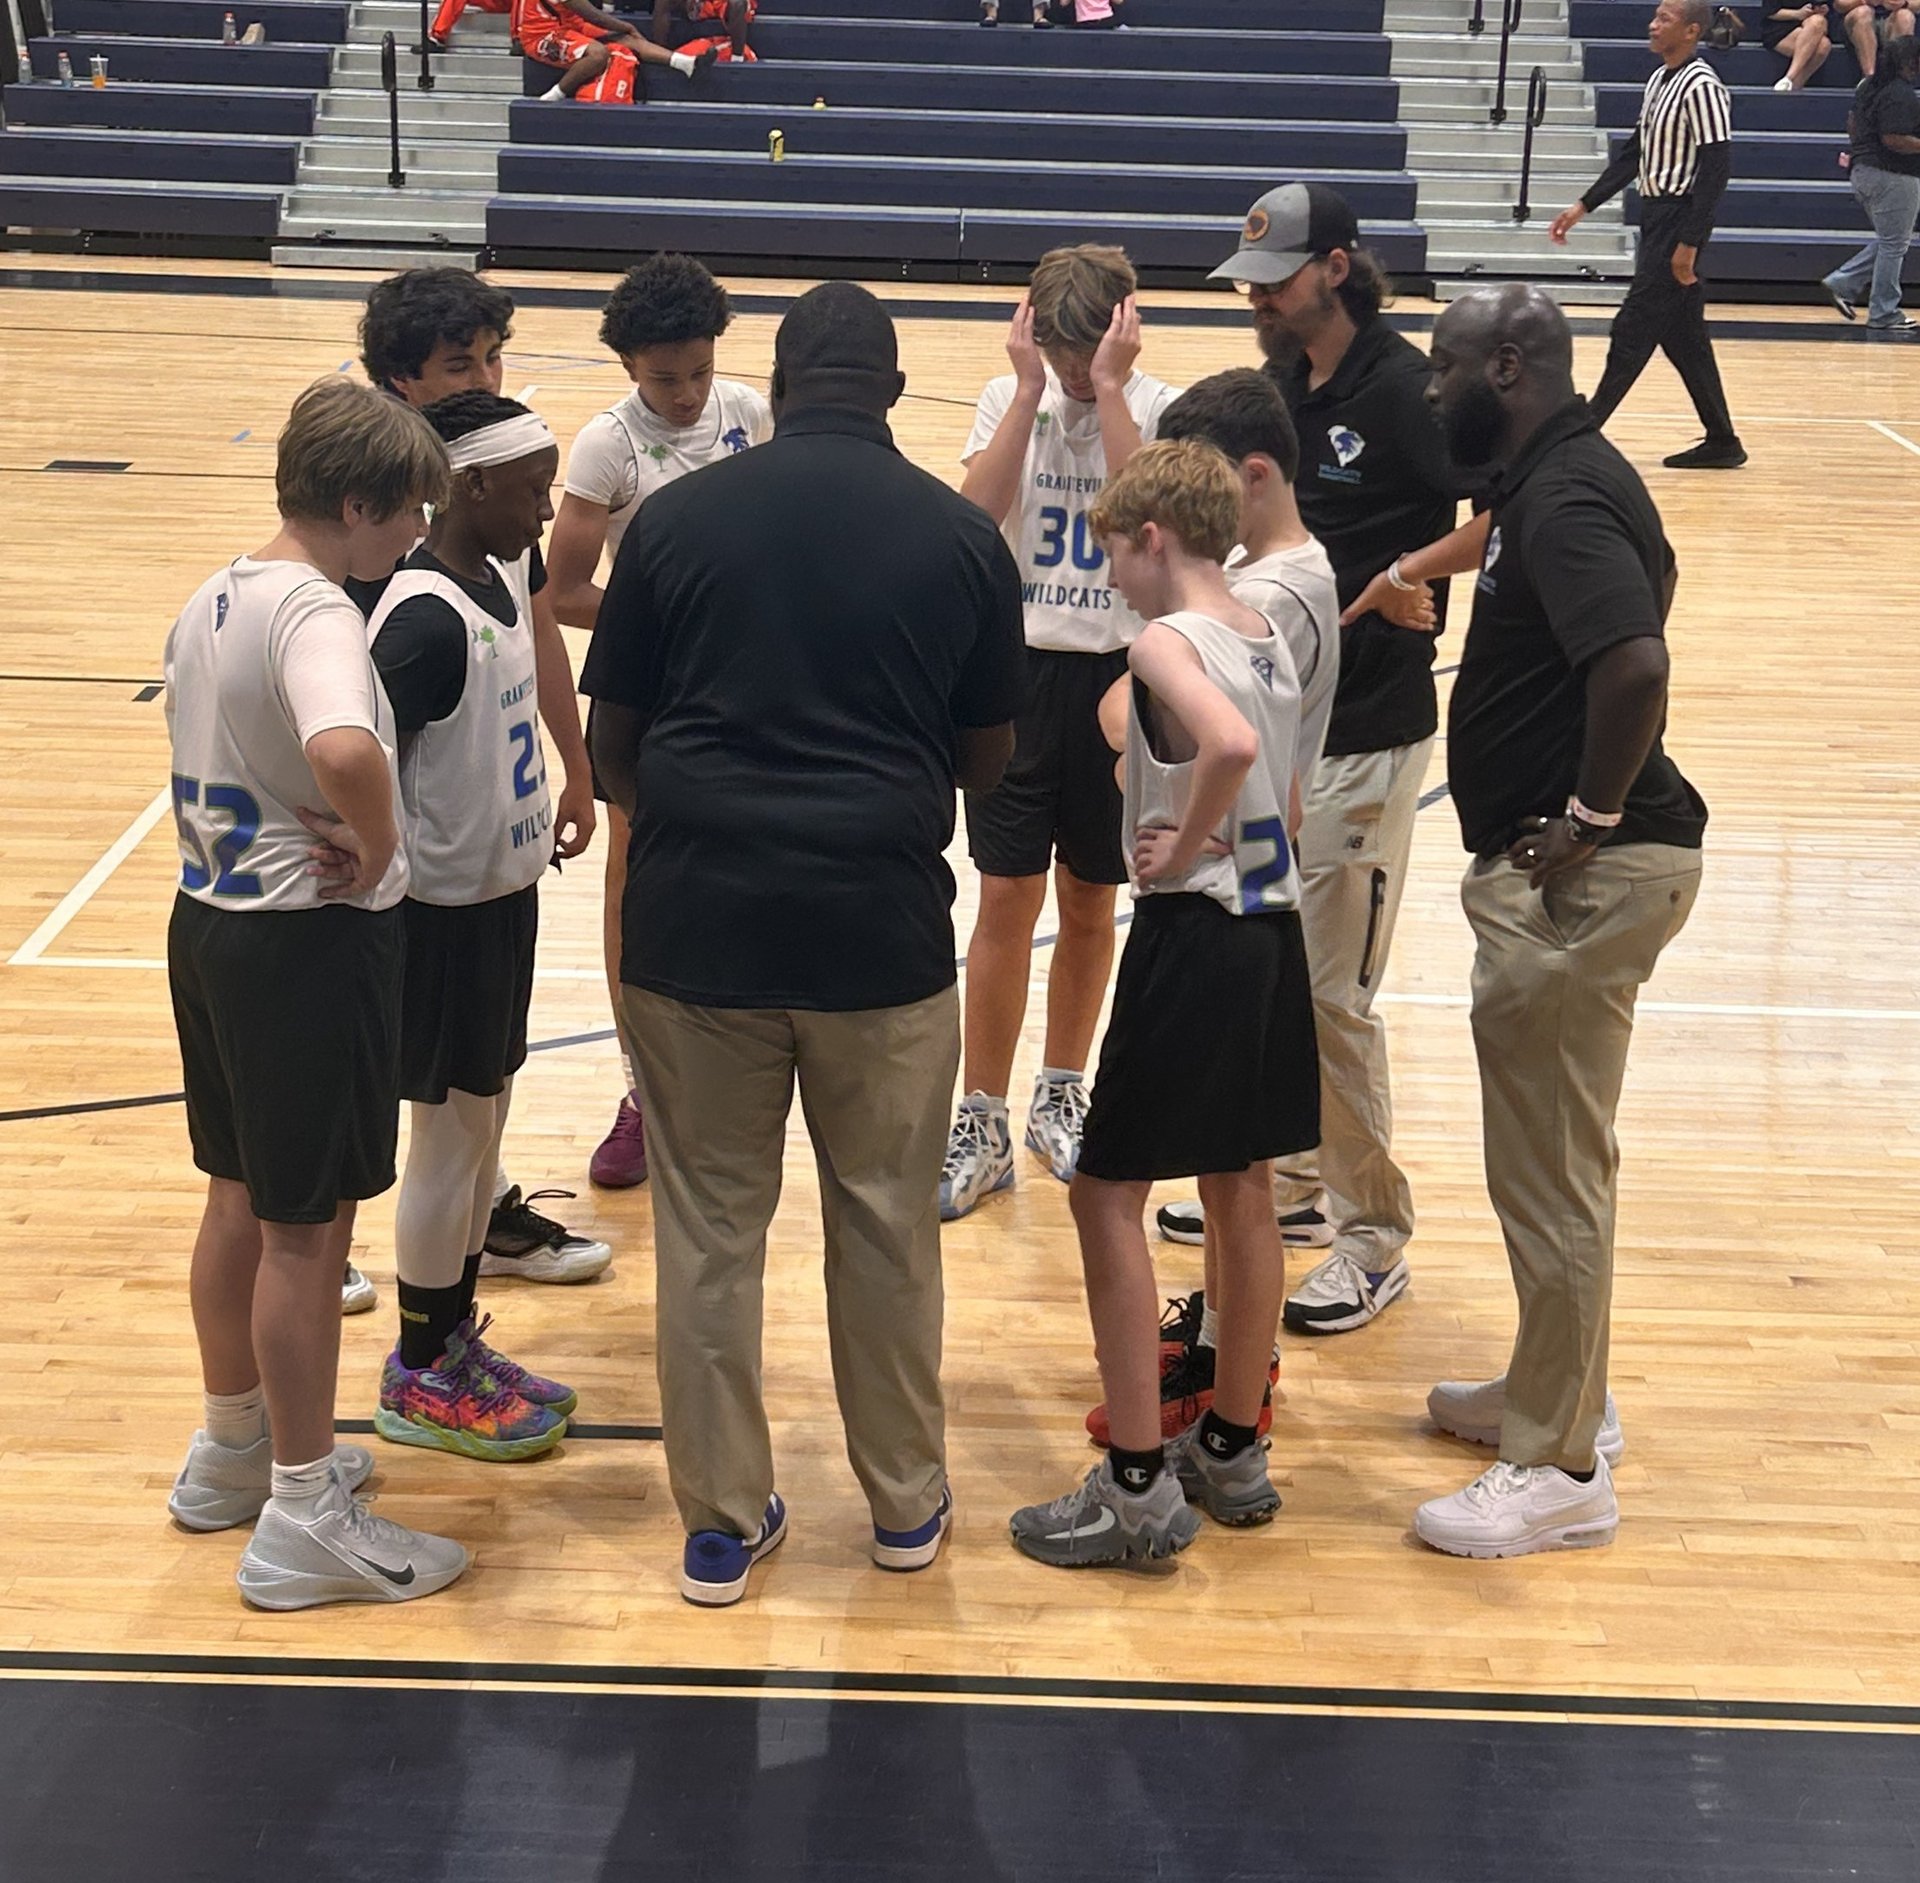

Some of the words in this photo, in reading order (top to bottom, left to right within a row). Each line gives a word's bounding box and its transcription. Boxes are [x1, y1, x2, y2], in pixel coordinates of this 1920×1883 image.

[1033, 506, 1104, 571] 30
[1022, 581, 1112, 610] WILDCATS
[171, 771, 264, 897] 52
[1237, 815, 1295, 914] 2
